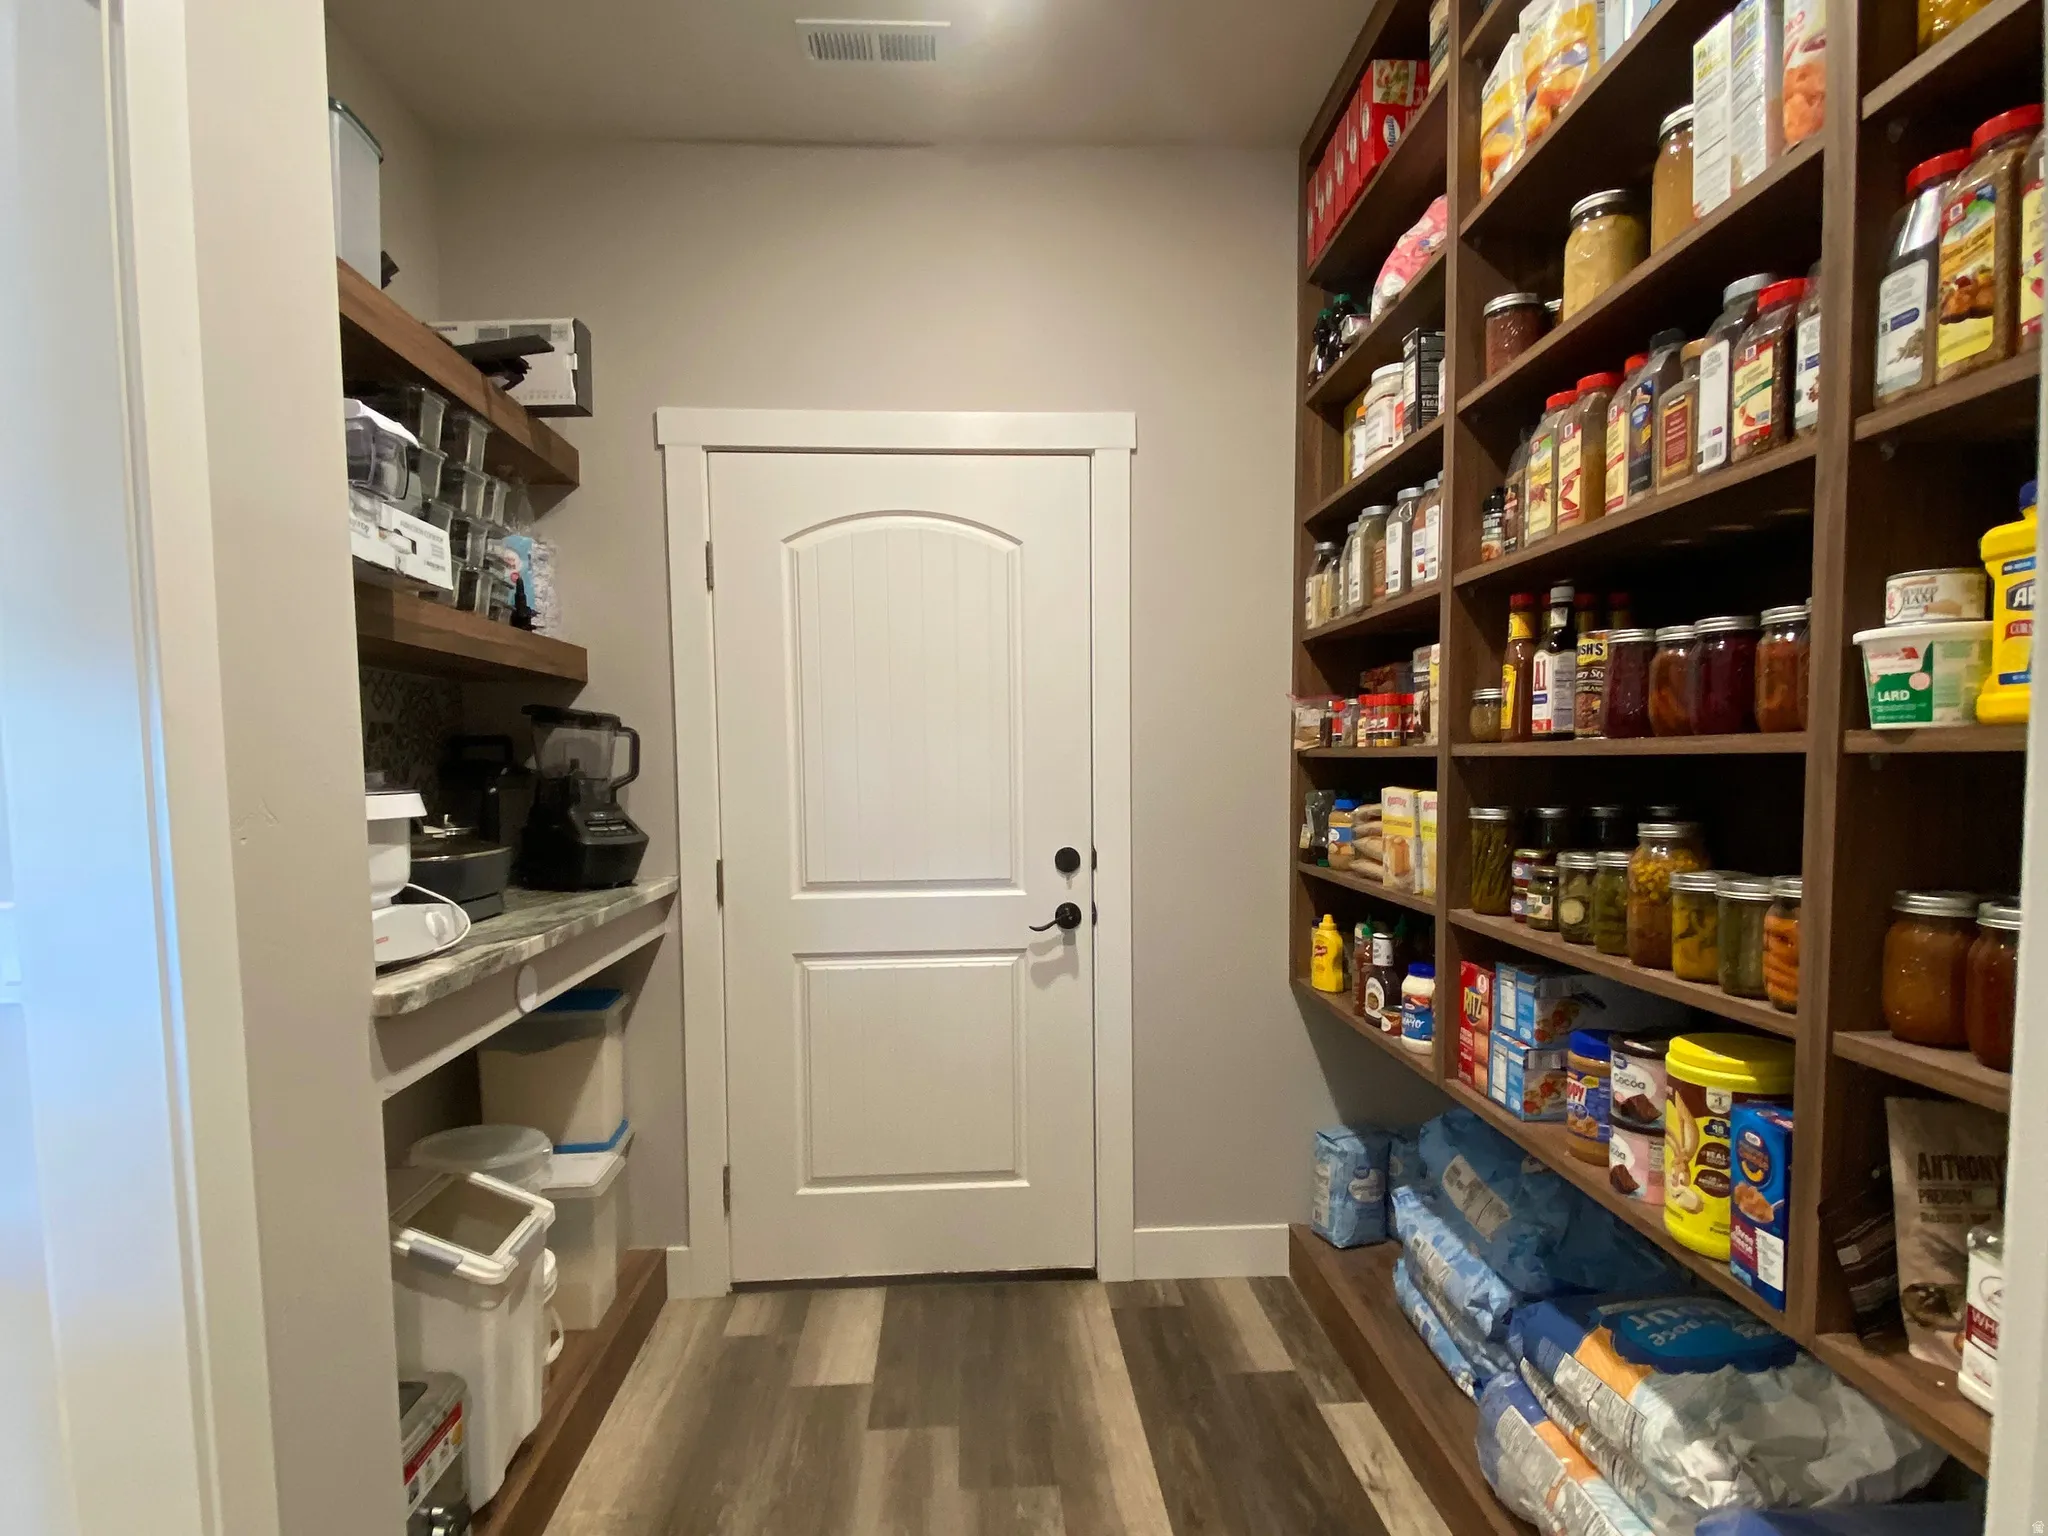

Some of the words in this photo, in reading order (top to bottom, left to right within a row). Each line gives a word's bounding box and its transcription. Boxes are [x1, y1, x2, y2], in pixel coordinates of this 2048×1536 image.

[1903, 595, 1935, 605] HAM
[1578, 643, 1604, 656] SH'S
[1877, 689, 1910, 702] LARD
[1463, 986, 1482, 1019] RITZ
[1567, 1081, 1586, 1102] PPY
